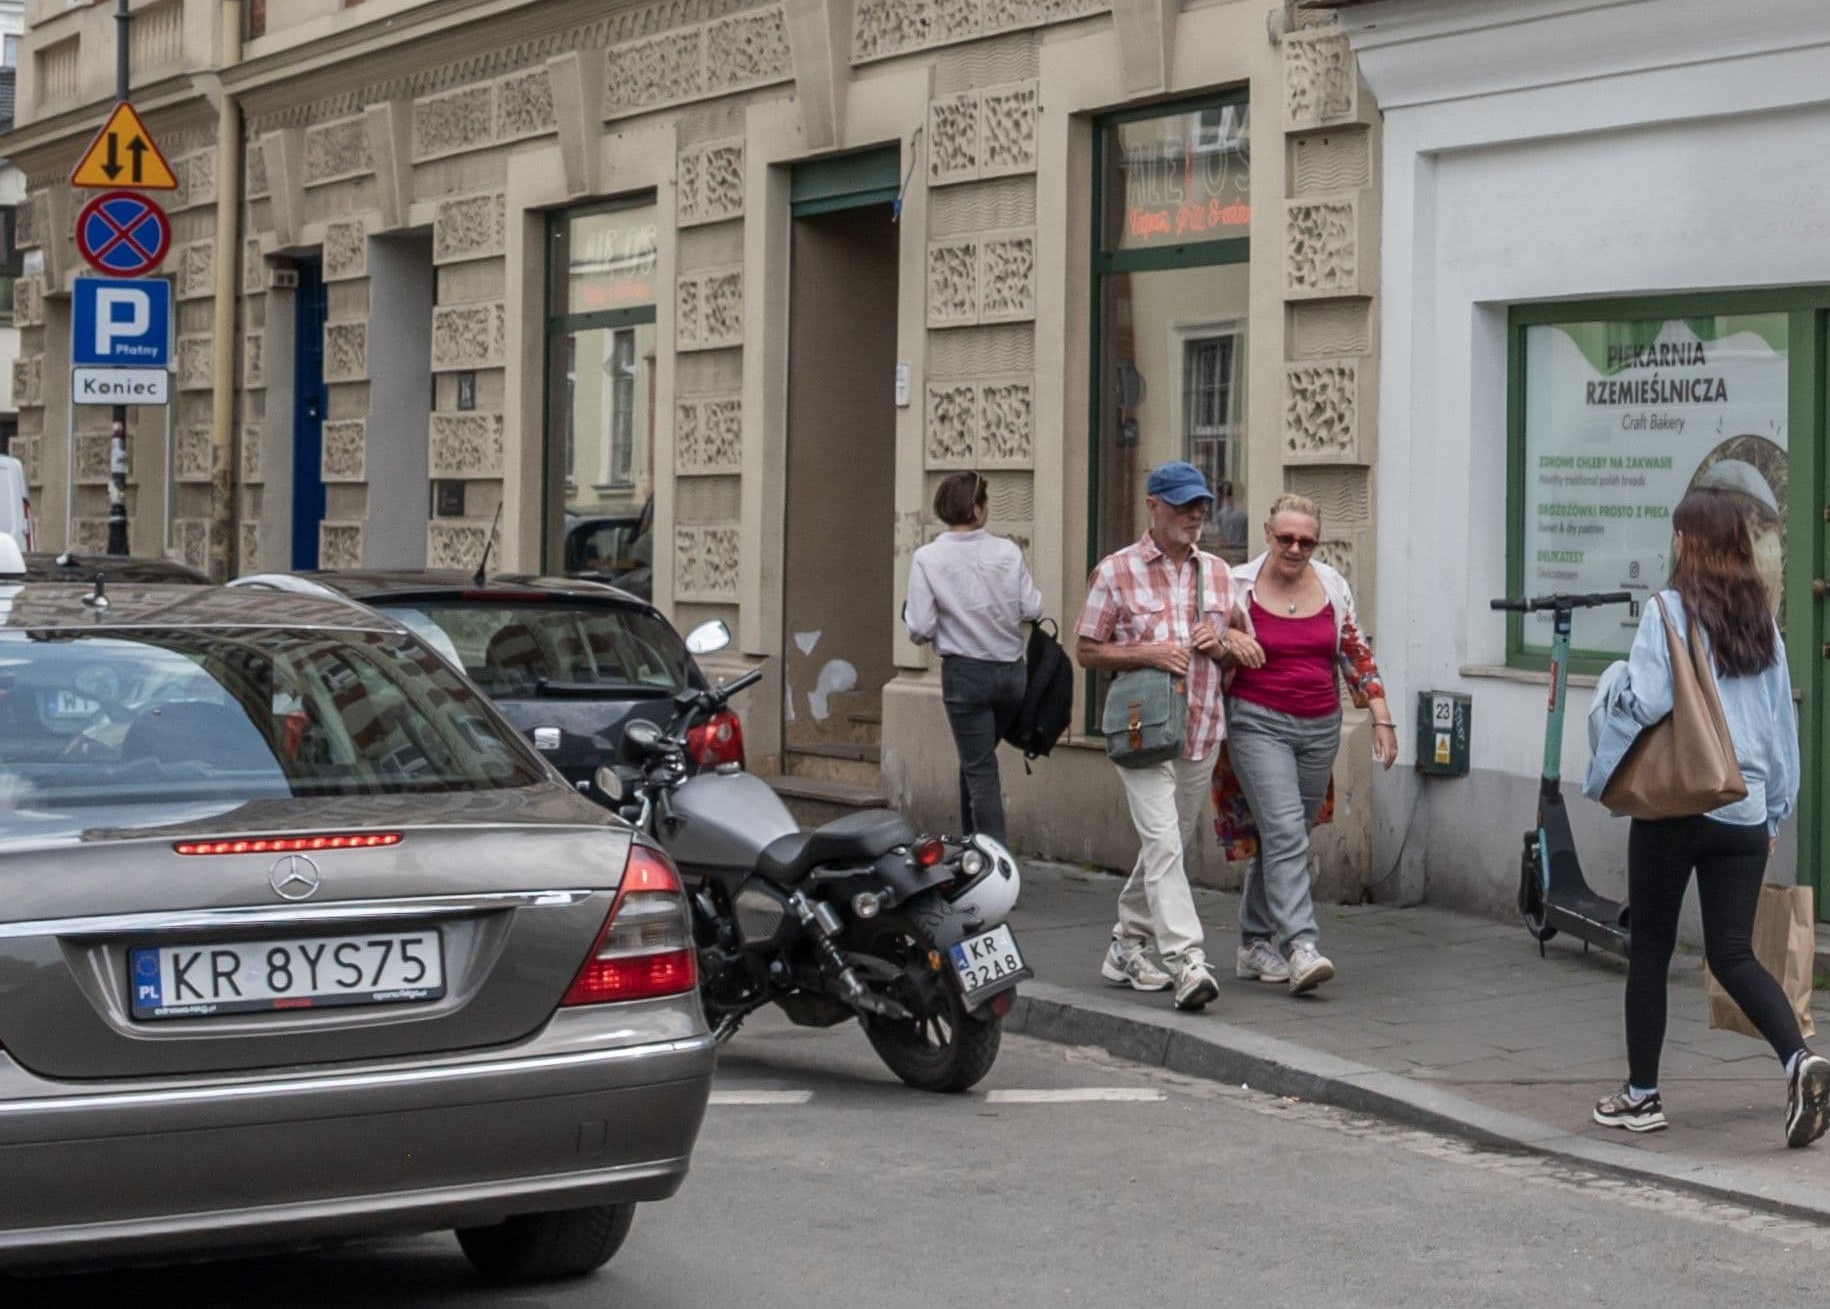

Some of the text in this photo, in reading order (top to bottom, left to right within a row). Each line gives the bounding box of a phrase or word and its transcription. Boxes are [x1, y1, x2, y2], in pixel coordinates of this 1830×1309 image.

[95, 287, 150, 355] P
[1607, 342, 1706, 369] PIEKARNIA
[83, 378, 157, 395] Koniec
[1586, 372, 1728, 405] RZEMIEŚLNICZA
[1621, 413, 1686, 434] Craft Bakery
[1436, 703, 1450, 720] 23
[969, 936, 997, 960] KR
[173, 938, 426, 1001] KR 8YS75
[965, 954, 1017, 988] 32A8
[139, 986, 159, 999] PL
